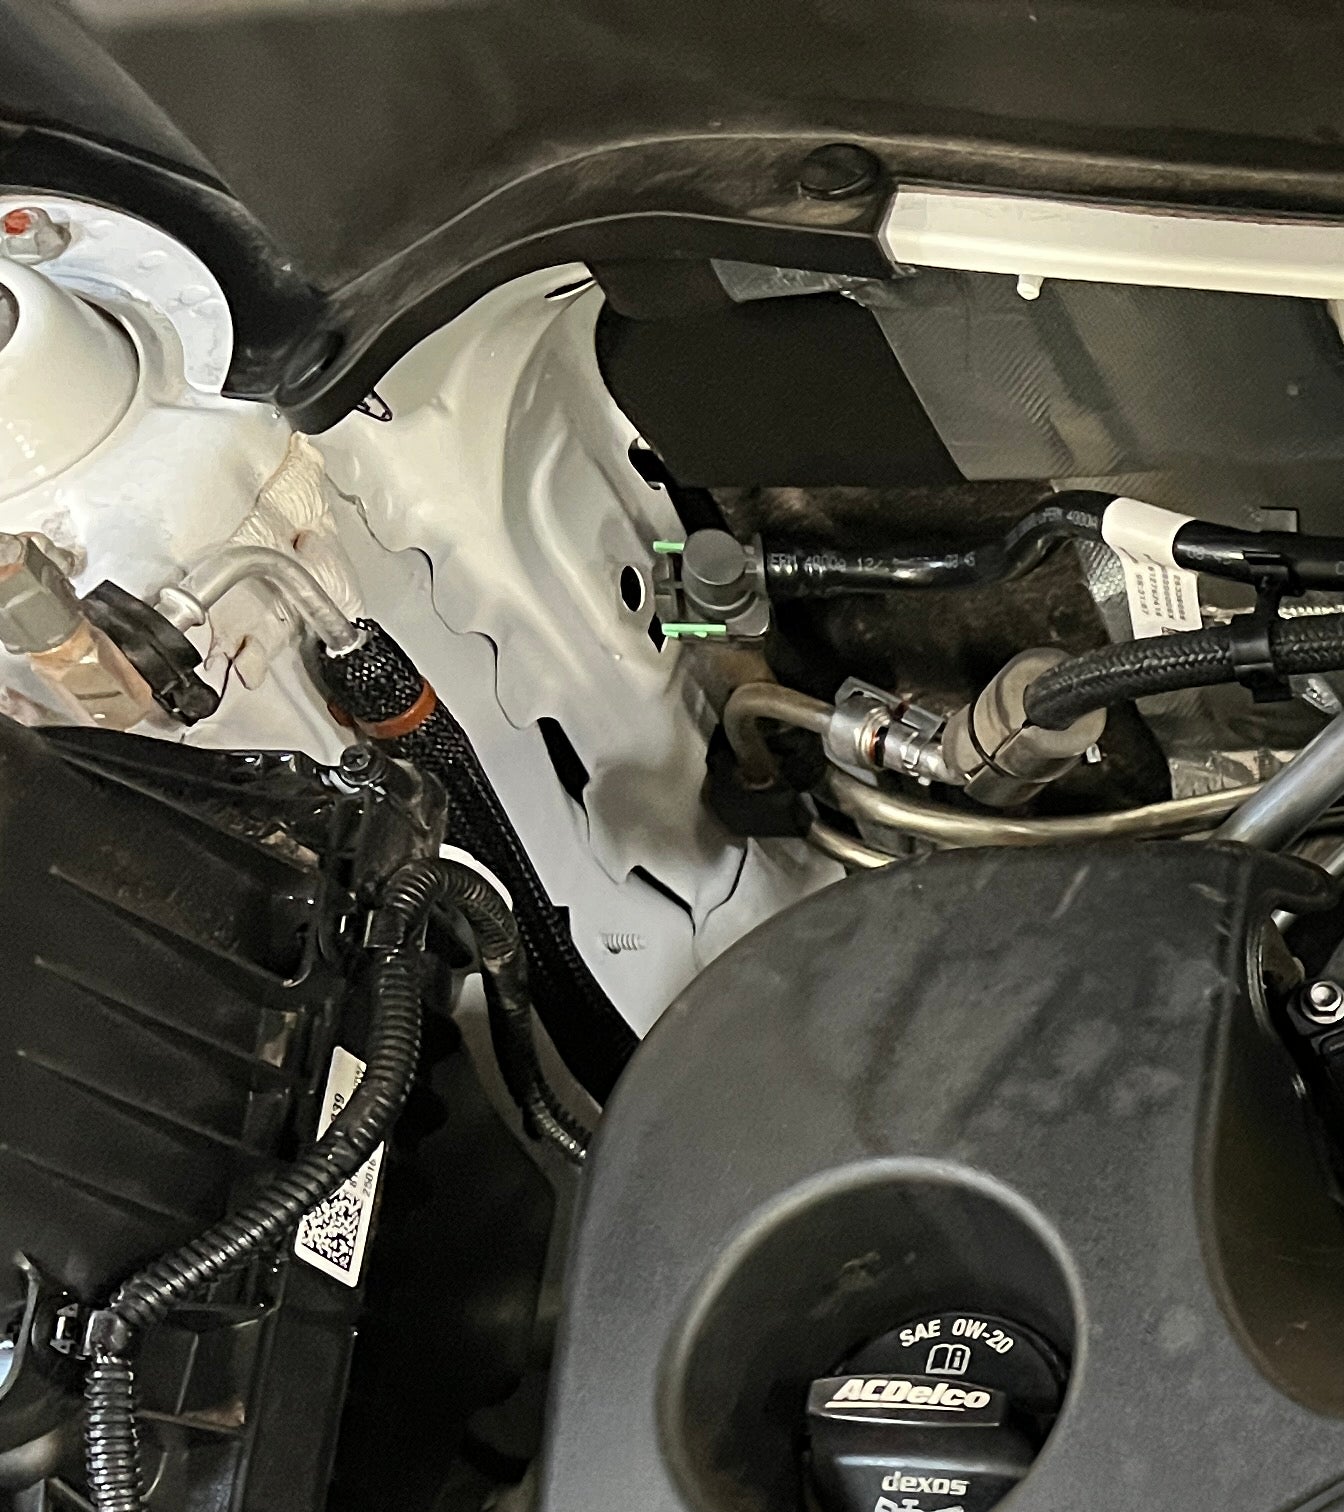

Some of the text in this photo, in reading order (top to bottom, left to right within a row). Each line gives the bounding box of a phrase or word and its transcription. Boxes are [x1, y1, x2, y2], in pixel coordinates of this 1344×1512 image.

[900, 1318, 1014, 1355] SAE 0W-20
[833, 1379, 992, 1409] ACDelco
[881, 1471, 971, 1496] dexos
